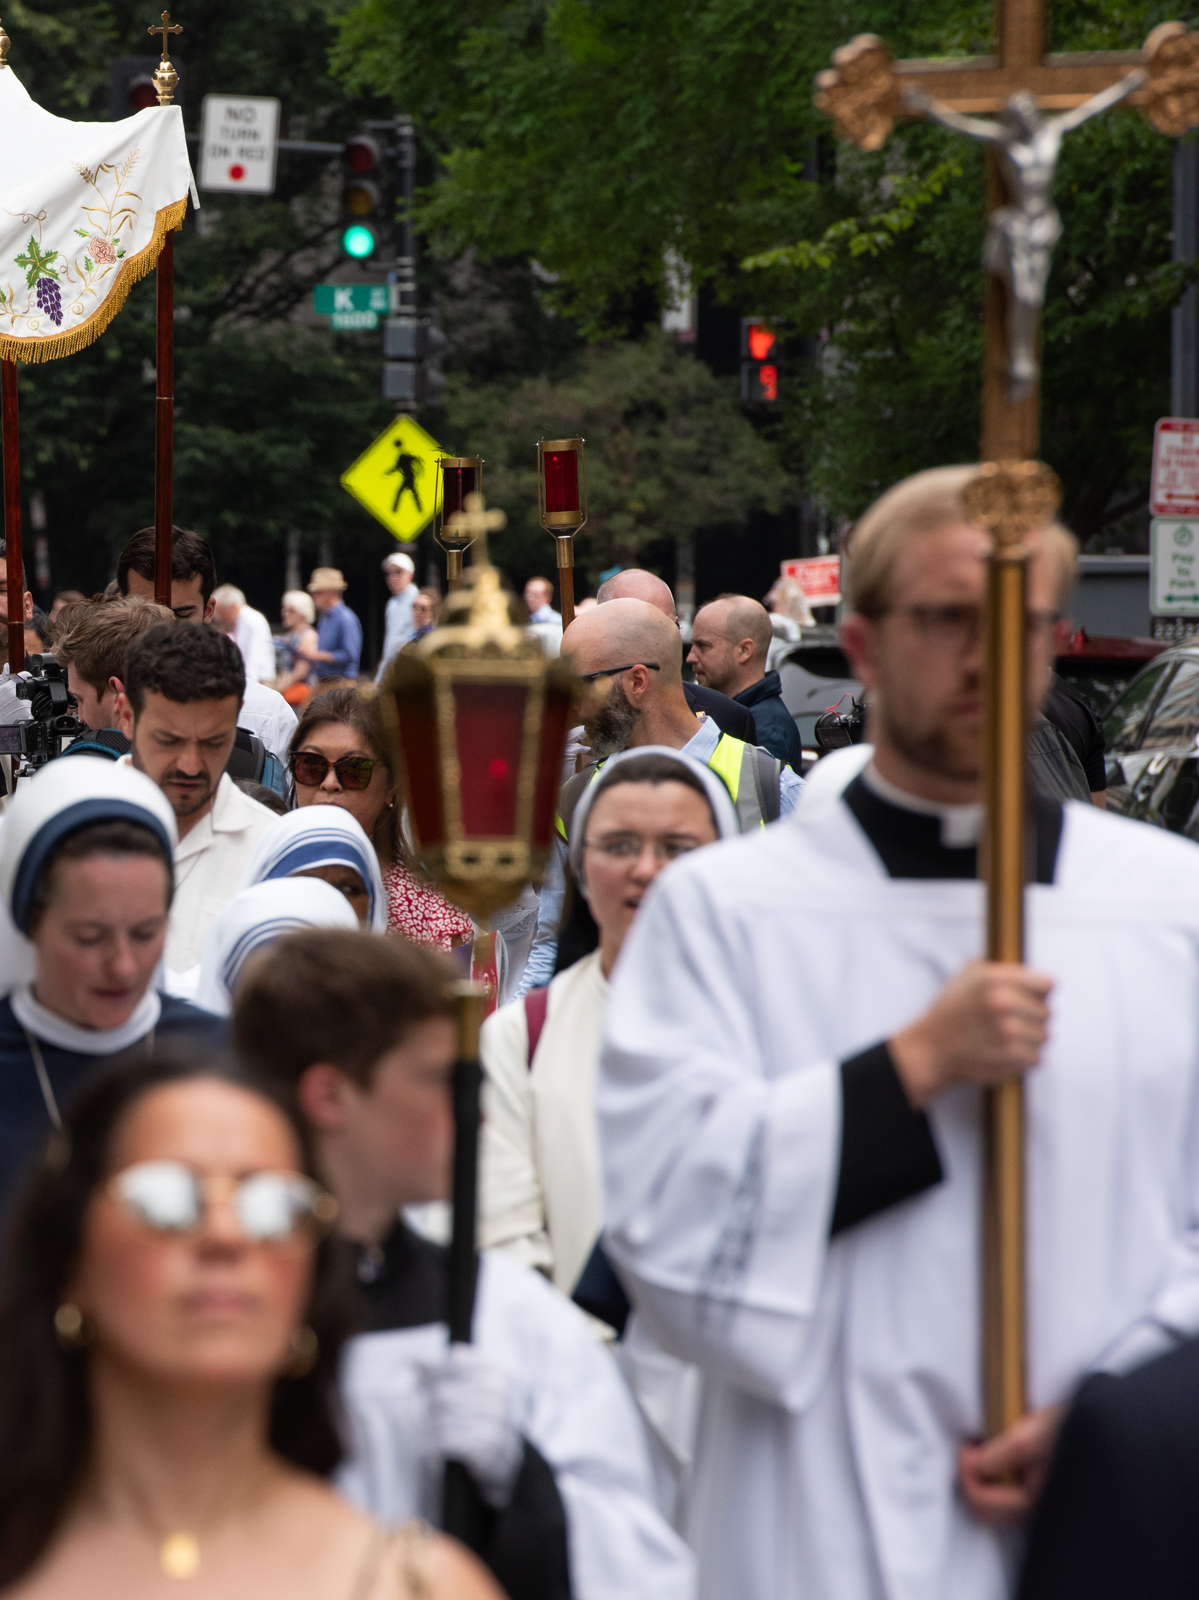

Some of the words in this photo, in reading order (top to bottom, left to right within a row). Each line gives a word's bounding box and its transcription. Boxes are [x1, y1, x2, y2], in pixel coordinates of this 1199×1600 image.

[224, 105, 258, 122] NO
[220, 125, 261, 140] TURN
[207, 143, 232, 158] ON
[238, 145, 266, 161] RED
[334, 287, 354, 310] K
